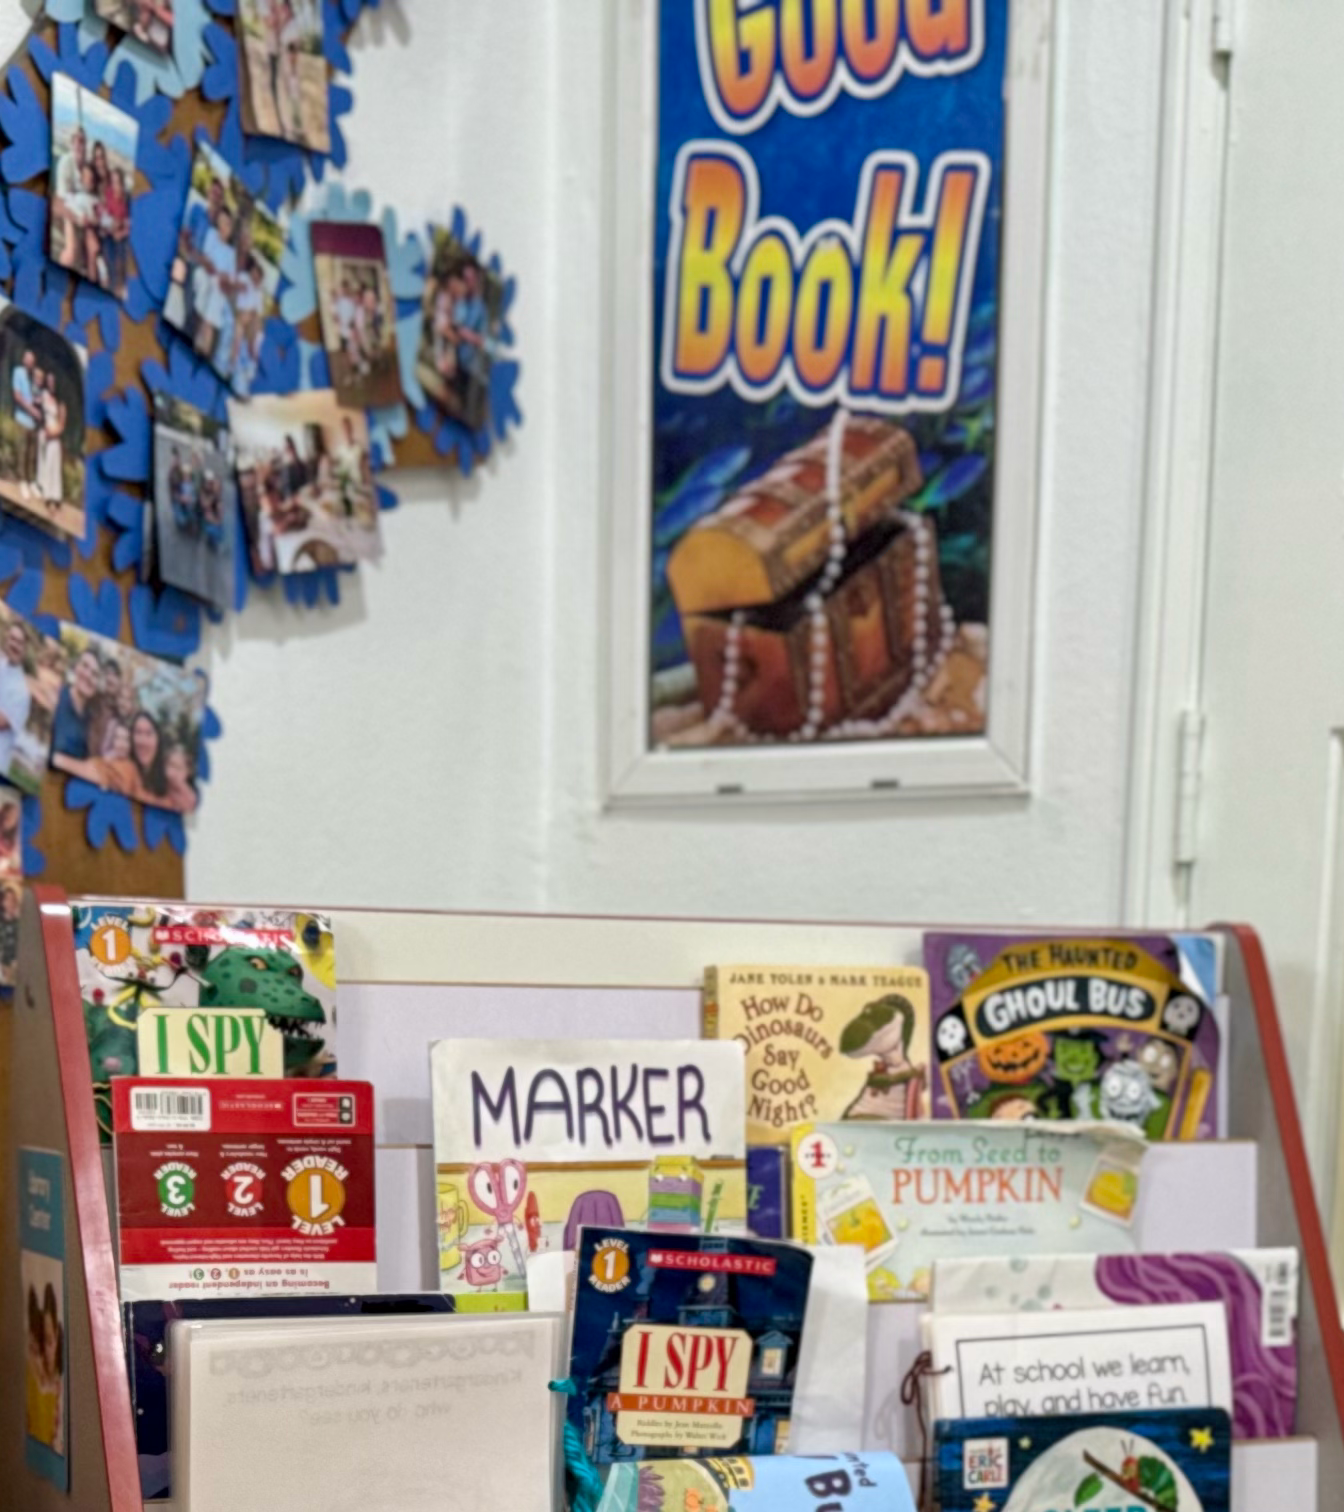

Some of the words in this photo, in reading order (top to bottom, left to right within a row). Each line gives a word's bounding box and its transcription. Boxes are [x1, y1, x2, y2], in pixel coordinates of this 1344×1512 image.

[702, 0, 976, 125] Goo
[668, 148, 982, 402] Book!
[102, 929, 117, 960] 1
[1001, 951, 1041, 974] THE
[1048, 943, 1138, 970] HAUNTED
[729, 973, 764, 985] JANE
[740, 995, 790, 1022] How
[795, 992, 824, 1022] Do
[983, 979, 1080, 1032] GHOUL
[1087, 977, 1148, 1019] BUS
[153, 1014, 170, 1075] I
[186, 1013, 268, 1076] SPY
[732, 1018, 834, 1060] Dinosaurs
[763, 1043, 800, 1071] Say
[751, 1068, 811, 1096] Good
[471, 1063, 711, 1147] MARKER
[746, 1093, 818, 1128] Night?
[894, 1136, 963, 1163] From
[972, 1136, 1028, 1163] Seed
[1039, 1144, 1062, 1164] to
[153, 1162, 197, 1180] READER
[220, 1162, 266, 1180] READER
[280, 1155, 349, 1182] READER
[166, 1175, 186, 1204] 3
[233, 1175, 254, 1204] 2
[309, 1174, 330, 1219] 1
[891, 1166, 1065, 1205] PUMPKIN
[160, 1202, 195, 1218] LEVEL
[227, 1202, 264, 1217] LEVEL
[290, 1214, 346, 1236] LEVEL
[595, 1238, 630, 1252] LEVEL
[259, 1267, 282, 1276] easy
[603, 1251, 616, 1279] 1
[665, 1254, 773, 1273] SCHOLASTIC
[168, 1281, 200, 1290] reader
[202, 1280, 263, 1290] independent
[281, 1280, 330, 1290] Becoming
[589, 1275, 632, 1293] READER
[633, 1331, 653, 1388] I
[664, 1332, 741, 1391] SPY
[978, 1362, 1009, 1385] At
[1015, 1355, 1086, 1382] school
[1093, 1357, 1124, 1378] we
[1130, 1351, 1192, 1377] learn,
[610, 1395, 623, 1409] A
[638, 1395, 752, 1414] PUMPKIN
[984, 1393, 1031, 1416] play,
[1042, 1391, 1081, 1413] and
[1087, 1386, 1140, 1409] have
[969, 1454, 1002, 1469] ERIC
